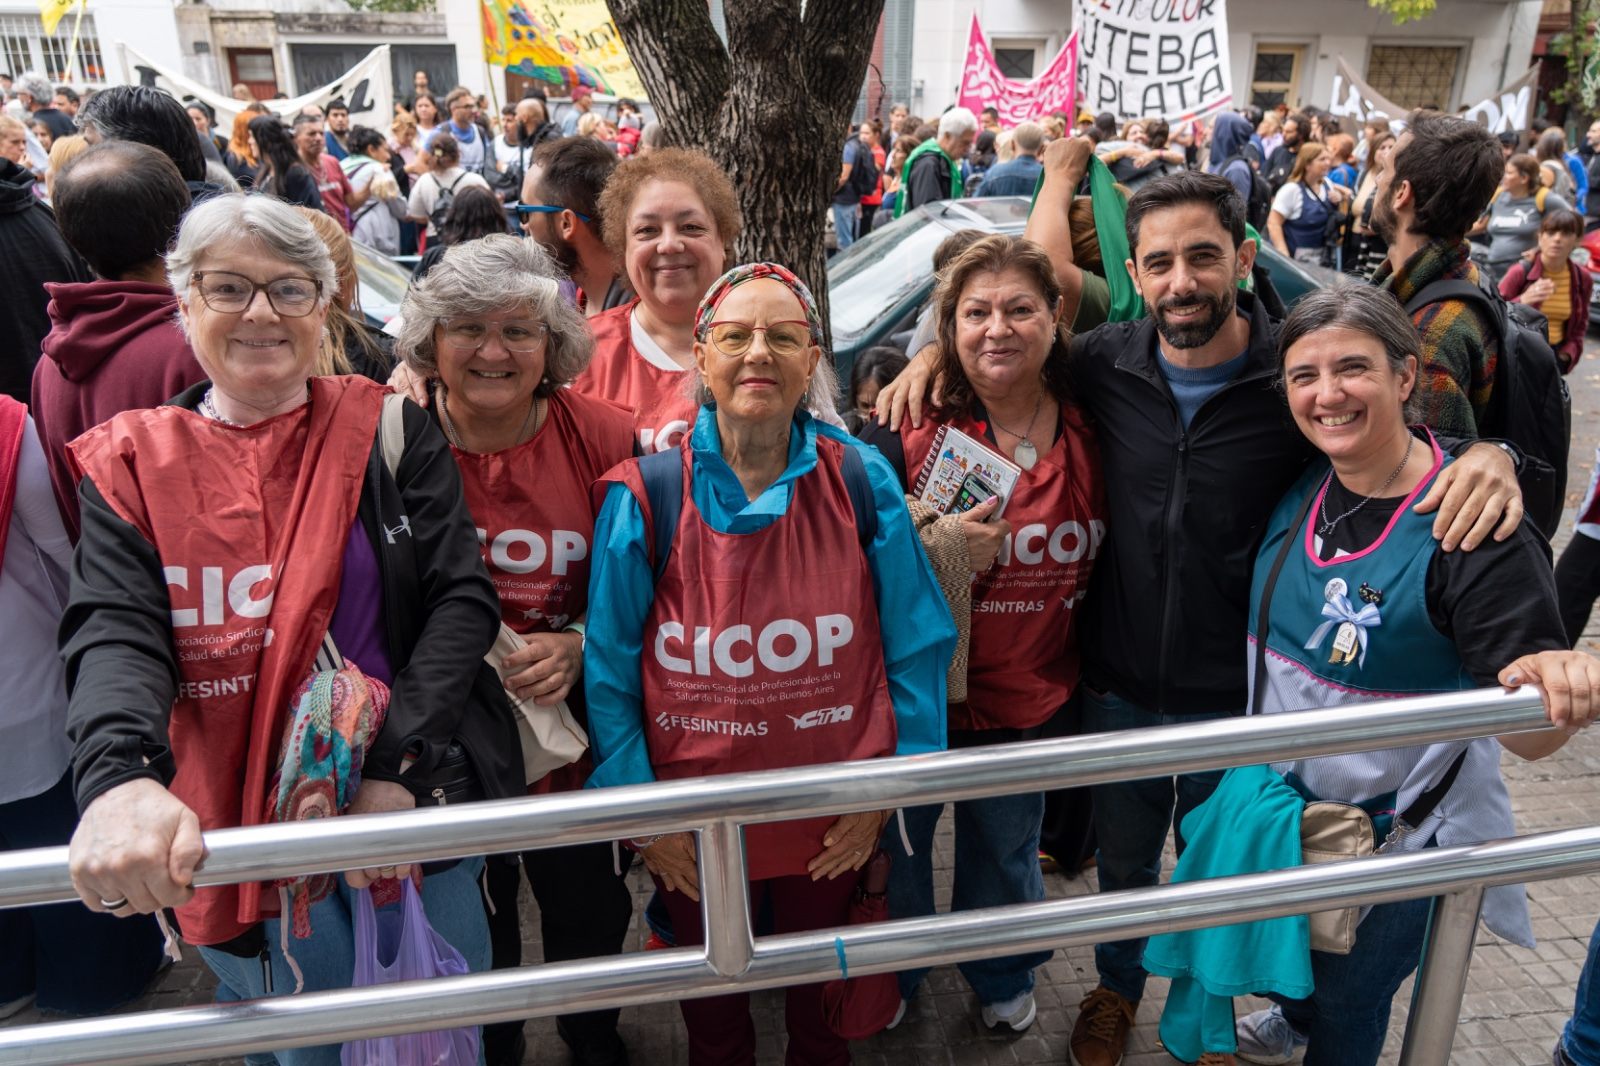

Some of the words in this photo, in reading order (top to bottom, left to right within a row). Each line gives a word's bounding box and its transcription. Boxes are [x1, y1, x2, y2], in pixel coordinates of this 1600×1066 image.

[1097, 64, 1224, 118] PLATA
[997, 519, 1106, 567] ICOP
[1035, 568, 1043, 577] de
[493, 579, 552, 590] Profesionales
[1013, 579, 1047, 589] Provincia
[508, 591, 542, 601] Buenos
[971, 600, 1045, 613] ESINTRAS
[226, 624, 267, 643] Sindica
[179, 649, 209, 662] Salud
[210, 647, 226, 659] de
[229, 645, 240, 656] la
[654, 613, 854, 678] CICOP
[178, 672, 257, 699] FESINT
[667, 678, 711, 691] Asociación
[712, 683, 746, 694] Sindical
[748, 684, 759, 693] de
[761, 674, 821, 691] Profesionales
[821, 672, 832, 682] de
[833, 671, 841, 680] la
[675, 691, 700, 702] Salud
[701, 693, 712, 703] de
[714, 694, 722, 704] la
[724, 695, 765, 705] Provincia
[767, 694, 778, 702] de
[779, 690, 813, 701] Buenos
[813, 685, 835, 697] Aires
[671, 715, 769, 736] FESINTRAS
